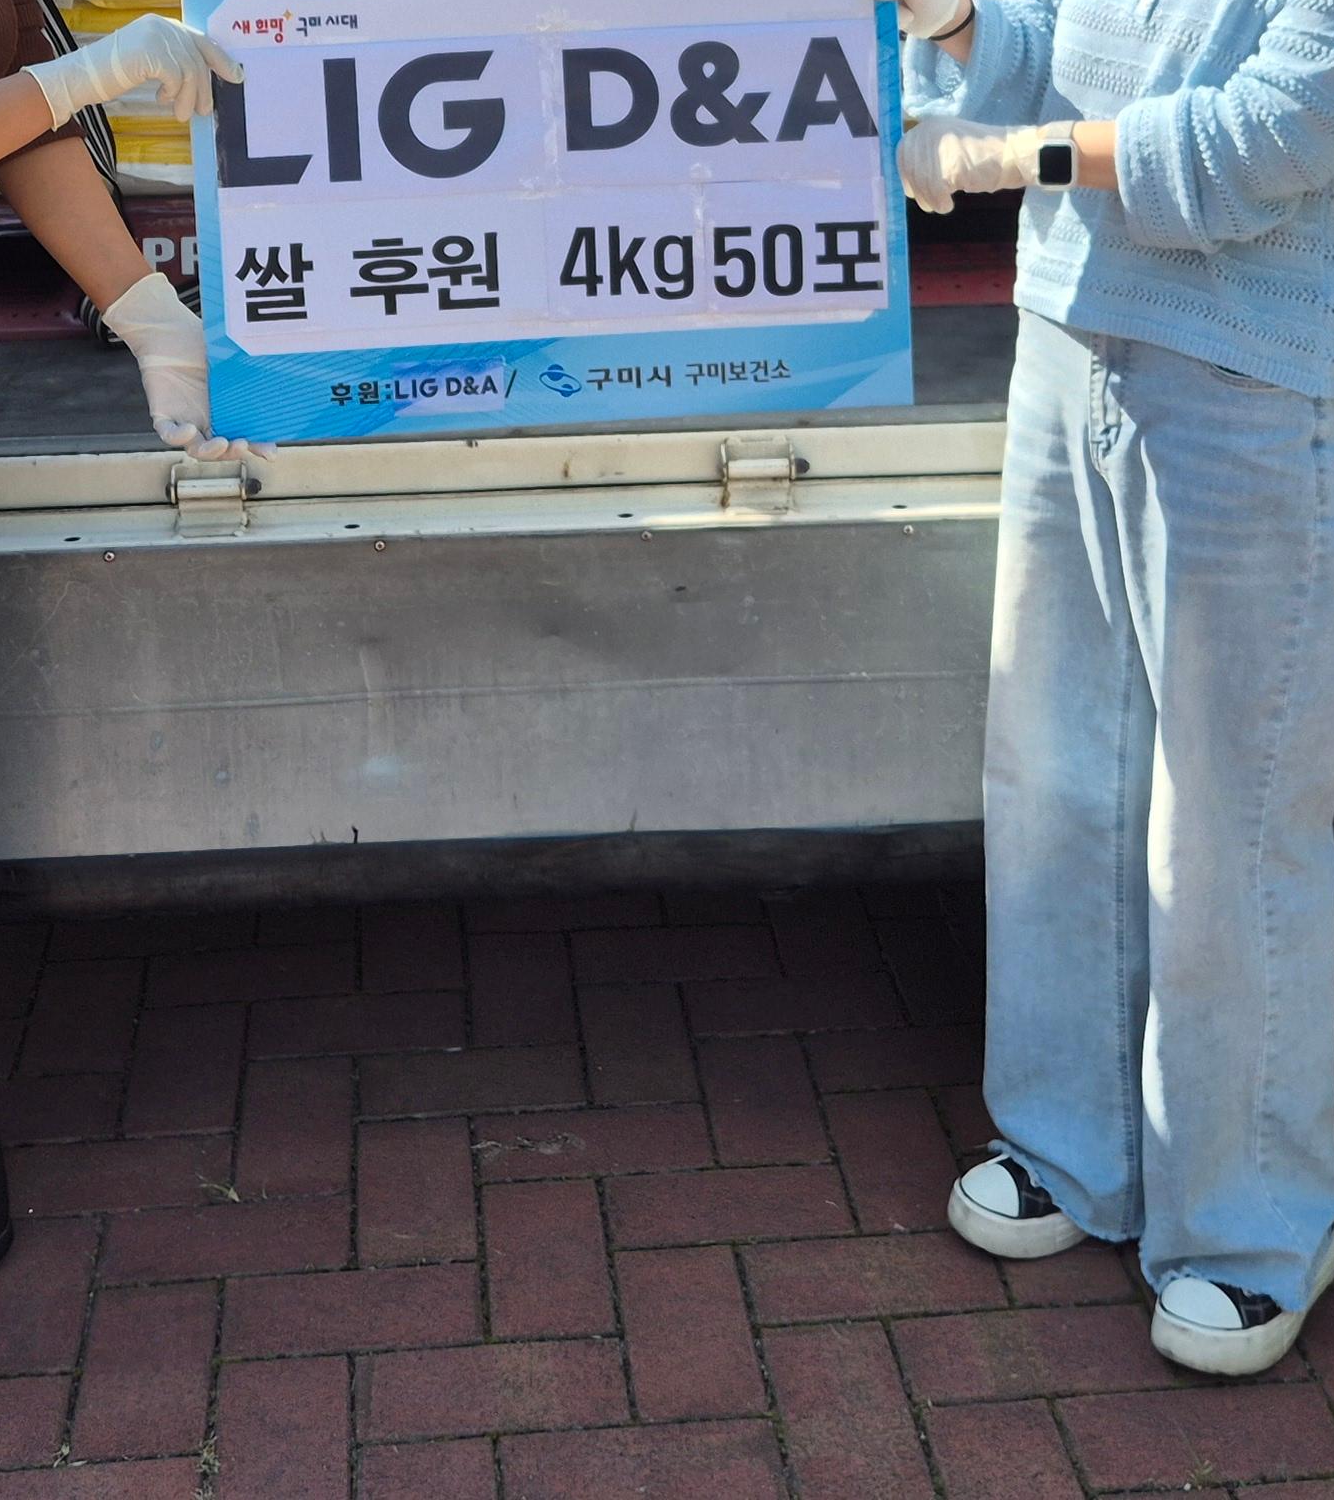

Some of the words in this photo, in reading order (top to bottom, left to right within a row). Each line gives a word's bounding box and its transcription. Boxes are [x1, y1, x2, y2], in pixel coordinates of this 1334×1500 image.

[231, 19, 251, 35] 새
[255, 17, 284, 43] 희망
[296, 15, 322, 37] 구미
[325, 14, 358, 30] 시대
[211, 49, 506, 188] LIG
[562, 36, 879, 152] D&A
[235, 242, 314, 322] 쌀
[350, 231, 500, 316] 후원
[559, 225, 695, 300] 4kg
[713, 220, 884, 298] 50포
[445, 374, 499, 397] D&A
[586, 364, 673, 391] 구미시
[684, 359, 792, 387] 구미보건소
